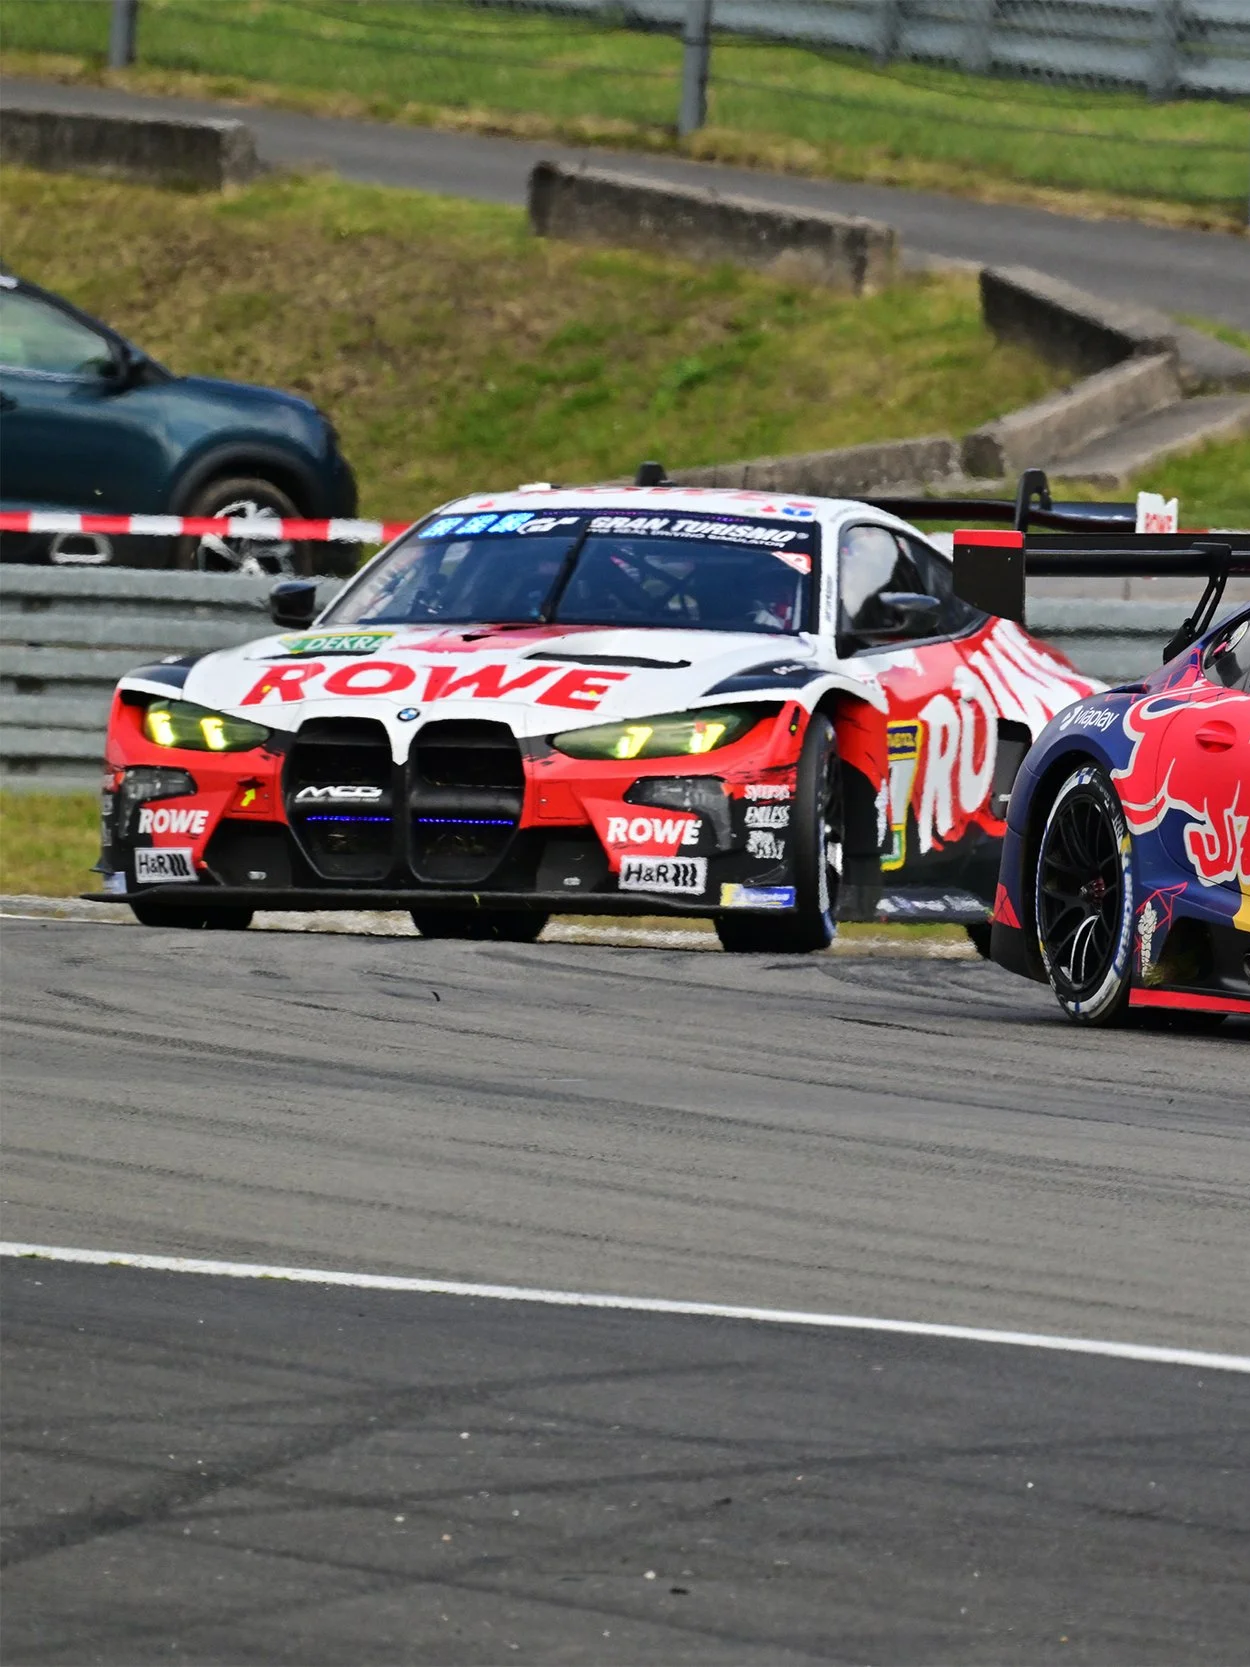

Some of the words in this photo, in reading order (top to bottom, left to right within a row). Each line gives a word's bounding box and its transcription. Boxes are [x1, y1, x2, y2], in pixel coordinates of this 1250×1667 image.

[589, 516, 669, 530] GRAN
[671, 519, 797, 543] TURISMO
[240, 661, 632, 711] ROWE
[138, 808, 210, 834] ROWE
[606, 817, 703, 845] ROWE
[139, 854, 169, 874] H&R
[624, 863, 669, 883] H&R
